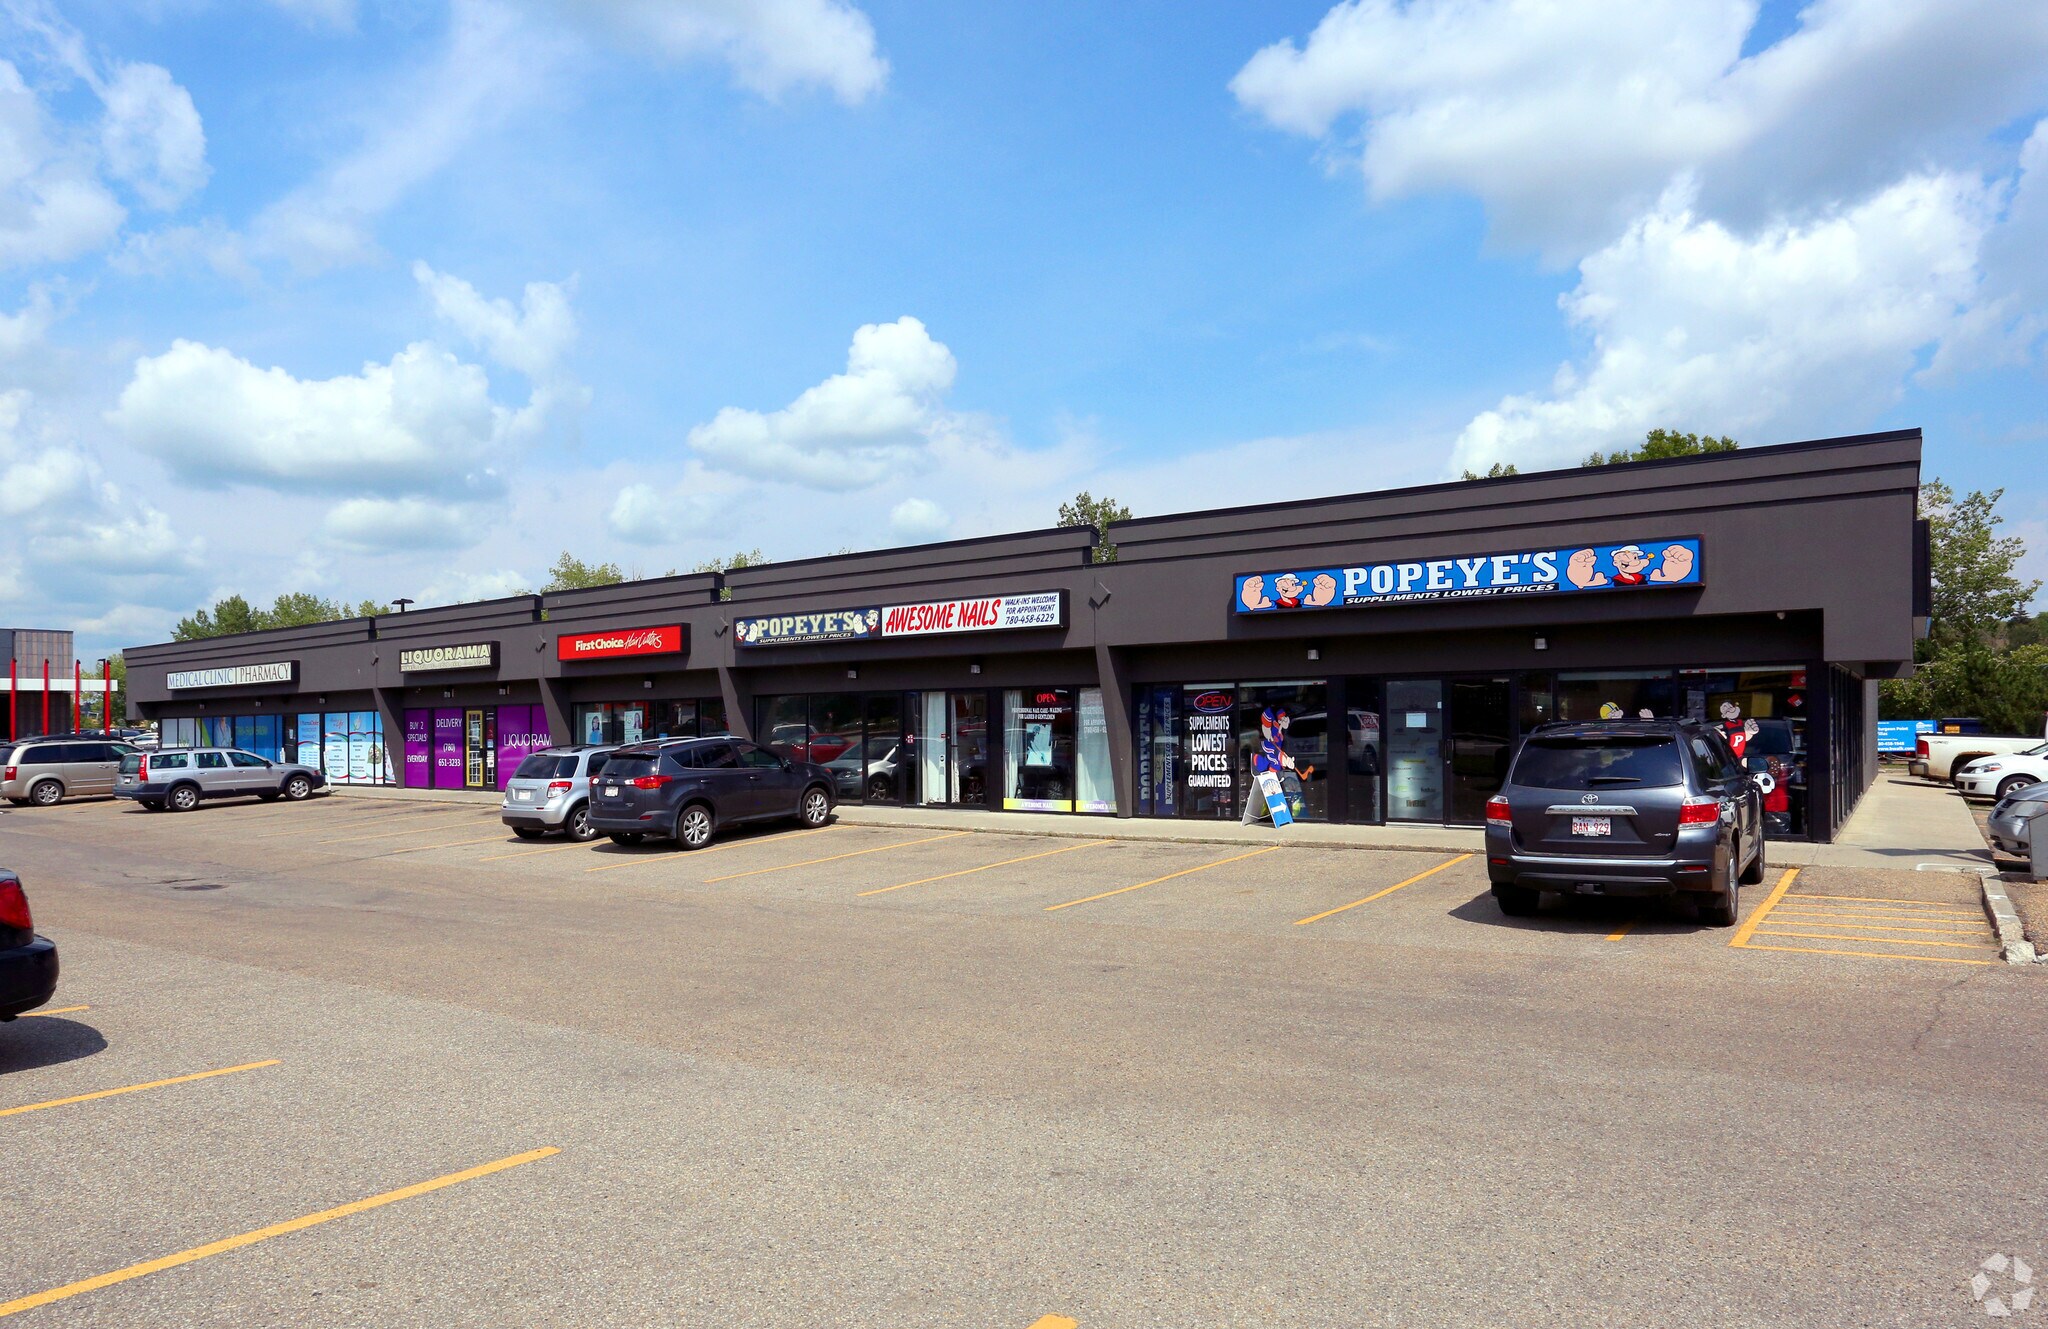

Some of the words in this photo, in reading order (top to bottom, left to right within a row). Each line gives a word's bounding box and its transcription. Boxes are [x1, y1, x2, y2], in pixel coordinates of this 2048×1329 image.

[1343, 551, 1559, 596] POPEYE'S
[1005, 597, 1030, 606] WALK-INS
[1031, 594, 1057, 604] WELCOME
[1346, 591, 1440, 605] SUPPLEMENTS
[1443, 587, 1502, 598] LOWEST
[1503, 583, 1555, 594] PRICES
[886, 603, 956, 633] AWESOME
[957, 598, 1001, 628] NAILS
[1005, 606, 1016, 615] FOR
[1016, 604, 1056, 614] APPOINTMENT
[757, 611, 855, 637] POPEYE'S
[1005, 613, 1055, 625] 780-458-6229
[575, 640, 595, 651] First
[595, 637, 624, 650] Choice
[759, 636, 802, 644] SUPPLEMENTS
[401, 644, 490, 665] LIQUORAMA
[169, 671, 203, 688] MEDICAL
[203, 668, 233, 686] CLINIC
[240, 663, 290, 682] PHARMACY
[1036, 693, 1057, 703] OPEN
[1196, 695, 1232, 707] OPEN
[409, 721, 418, 730] BUY
[420, 721, 424, 730] 2
[436, 718, 462, 728] DELIVERY
[1189, 716, 1230, 731] SUPPLEMENTS
[407, 733, 427, 742] SPECIALS
[1191, 733, 1227, 752] LOWEST
[1733, 735, 1744, 747] P
[443, 742, 456, 753] (780)
[407, 754, 428, 763] EVERYDAY
[438, 758, 461, 767] 651-3233
[1191, 754, 1228, 772] PRICES
[1188, 774, 1232, 788] GUARANTEED
